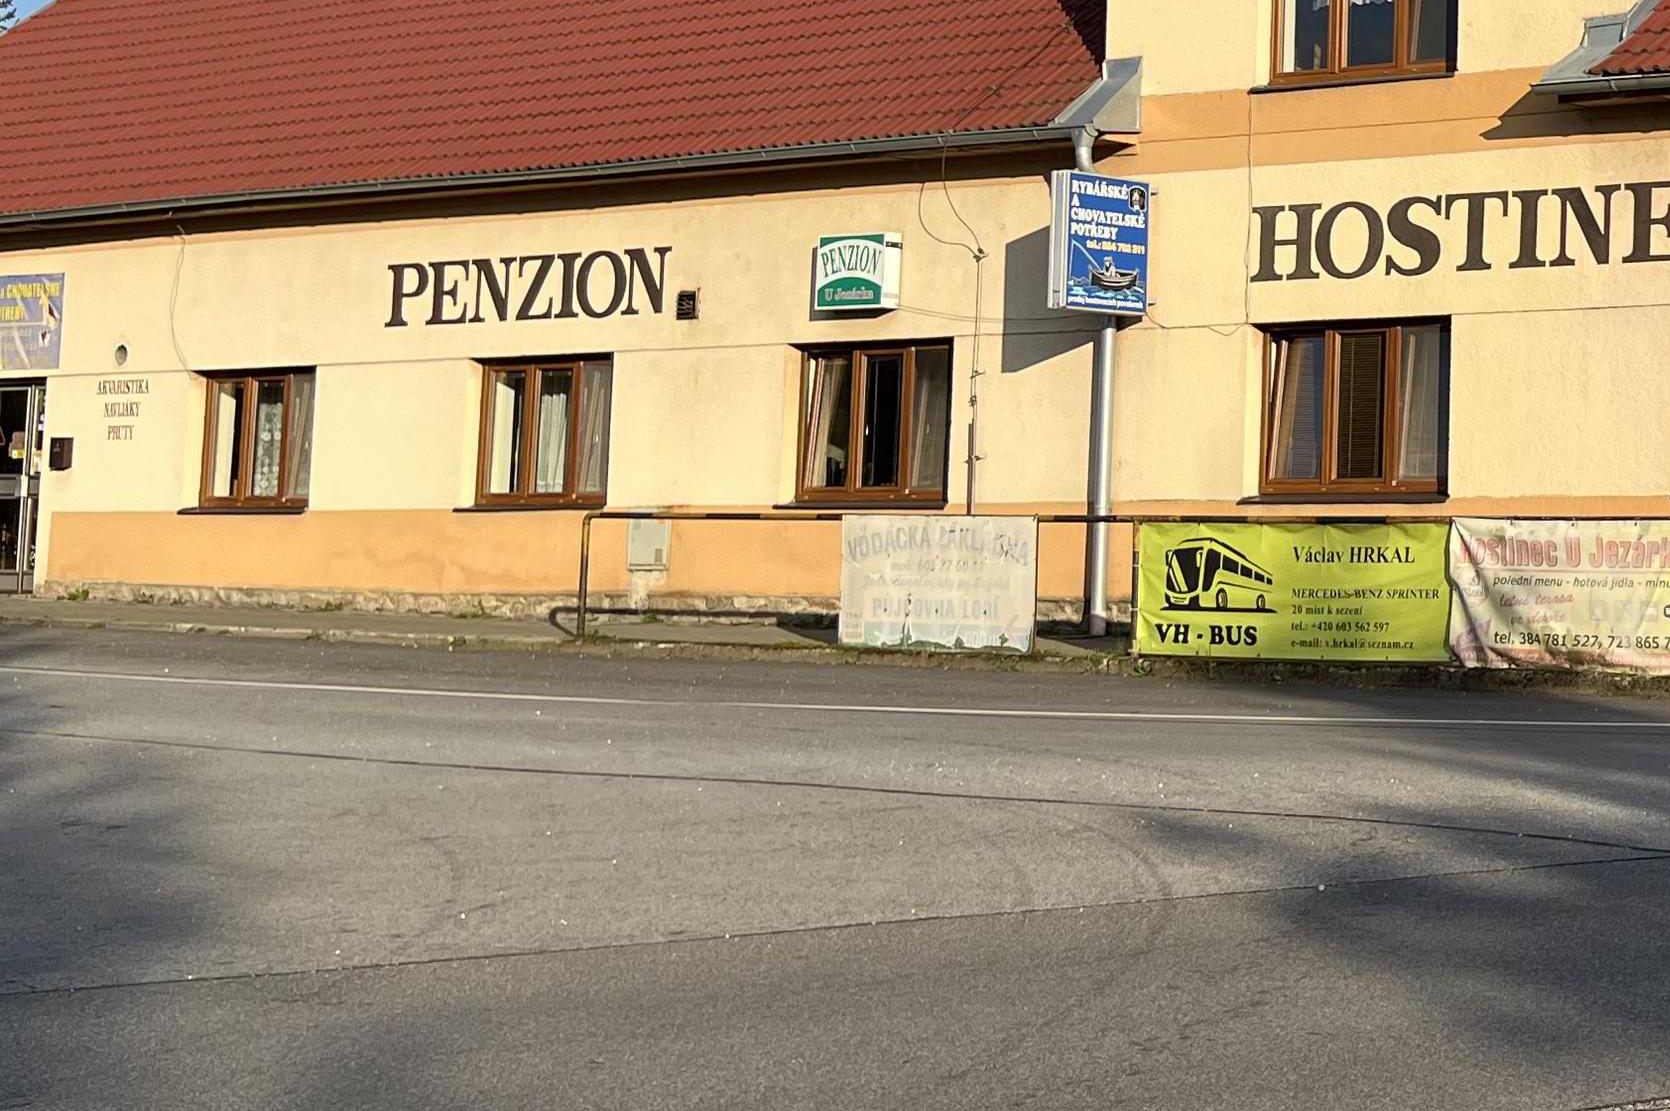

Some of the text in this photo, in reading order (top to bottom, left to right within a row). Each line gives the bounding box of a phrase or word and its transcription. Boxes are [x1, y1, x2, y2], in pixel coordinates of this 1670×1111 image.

[1072, 179, 1129, 200] RYBÁŘSKÉ
[1071, 194, 1080, 206] A
[1071, 206, 1146, 229] CHOVATELSKÉ
[1071, 222, 1118, 241] POTŘEBY
[820, 244, 883, 278] PENZION
[384, 244, 673, 327] PENZION
[824, 288, 834, 301] U
[96, 378, 150, 395] AKVARISTIKA
[107, 425, 135, 440] PRUTY
[1293, 545, 1416, 564] Václav HRKAL
[1565, 536, 1582, 568] U
[1492, 575, 1533, 588] polední
[1534, 577, 1563, 587] menu
[1573, 577, 1607, 588] hotová
[1609, 578, 1634, 590] jídla
[1292, 588, 1440, 600] MERCEDES-BENZ SPRINTER
[1291, 604, 1303, 615] 20
[1327, 604, 1333, 615] k
[1335, 605, 1363, 616] sezení
[1155, 623, 1190, 644] VH
[1209, 624, 1258, 646] BUS
[1291, 621, 1390, 633] tel.: +420 603 562 597
[1291, 637, 1415, 651] e-mail: v.hrkal@seznam.cz
[1494, 631, 1514, 645] tel.
[1519, 632, 1541, 646] 384
[1545, 633, 1568, 647] 781
[1573, 634, 1601, 649] 527,
[1607, 635, 1632, 649] 723
[1635, 635, 1660, 650] 865
